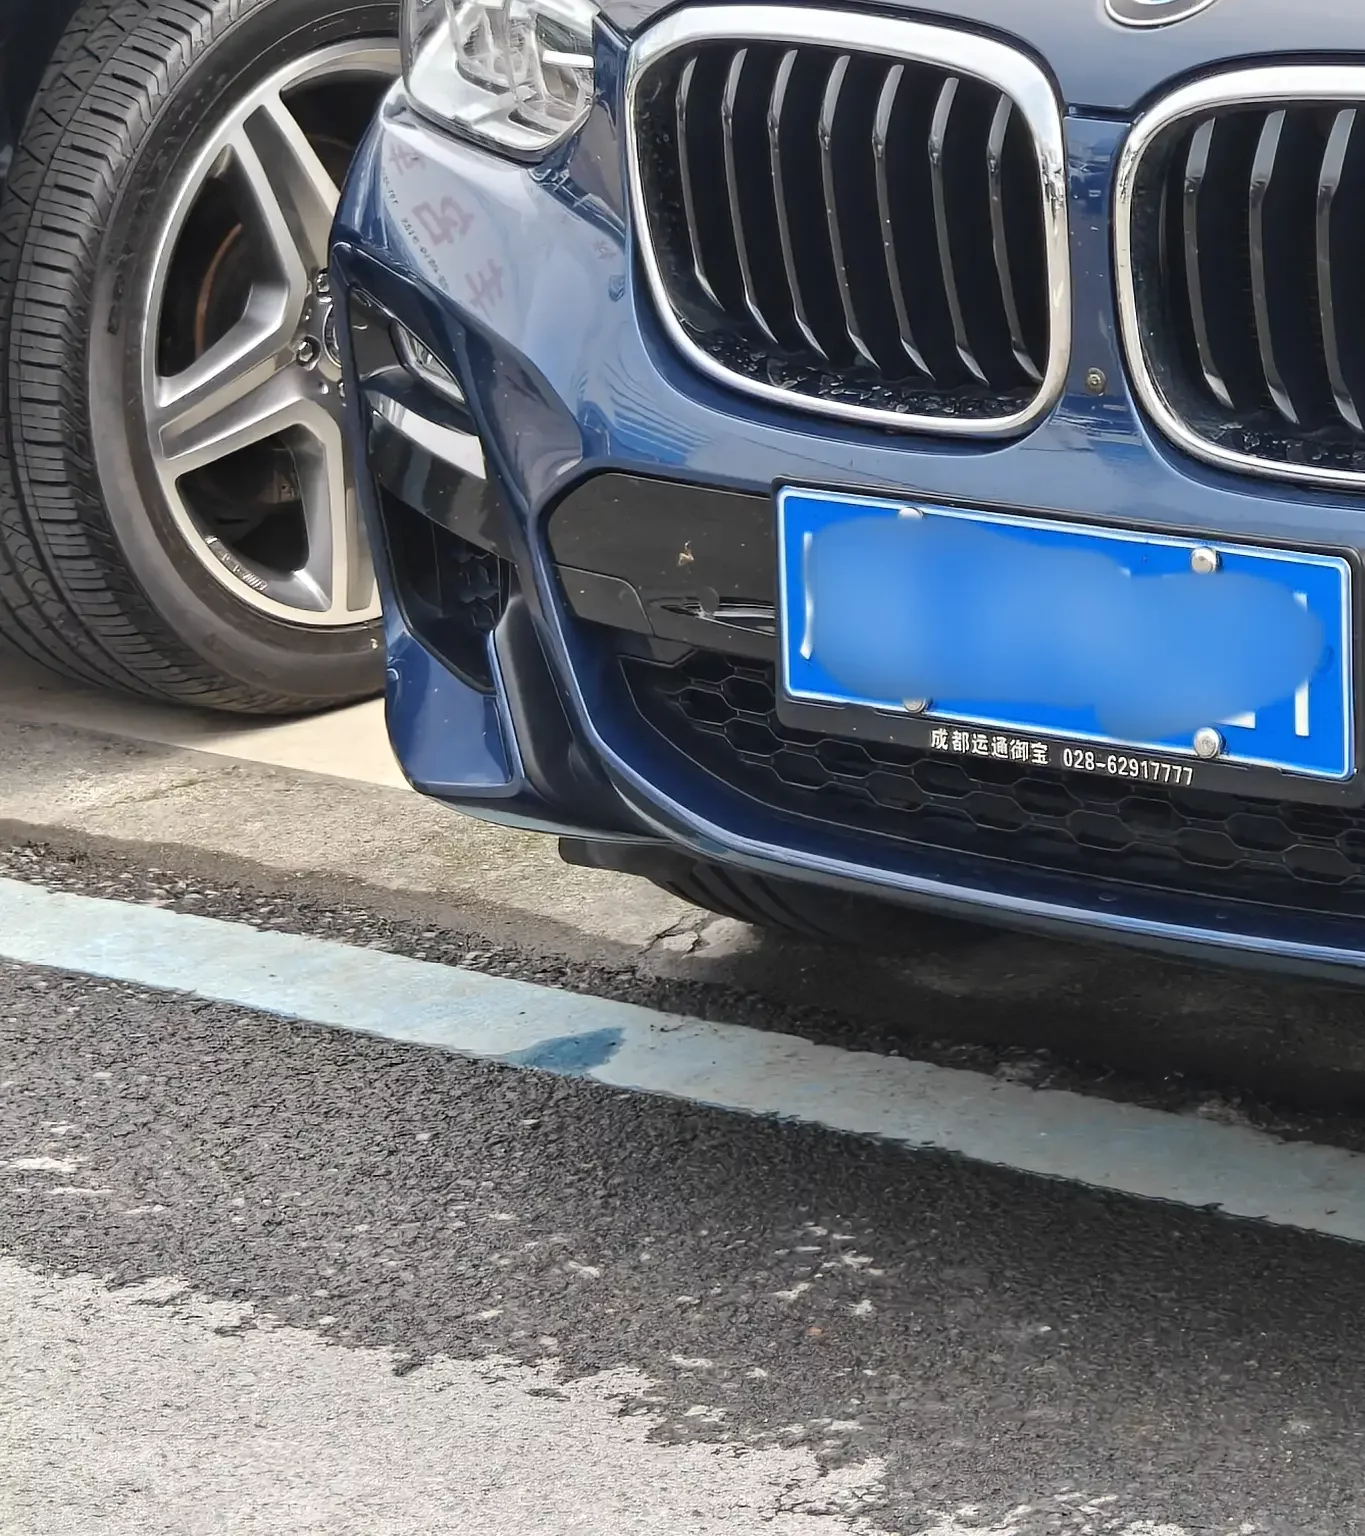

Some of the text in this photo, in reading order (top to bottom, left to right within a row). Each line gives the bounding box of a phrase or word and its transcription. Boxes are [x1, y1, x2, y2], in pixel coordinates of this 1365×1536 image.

[930, 728, 1194, 786] 成都运通御宝 028-62917777
